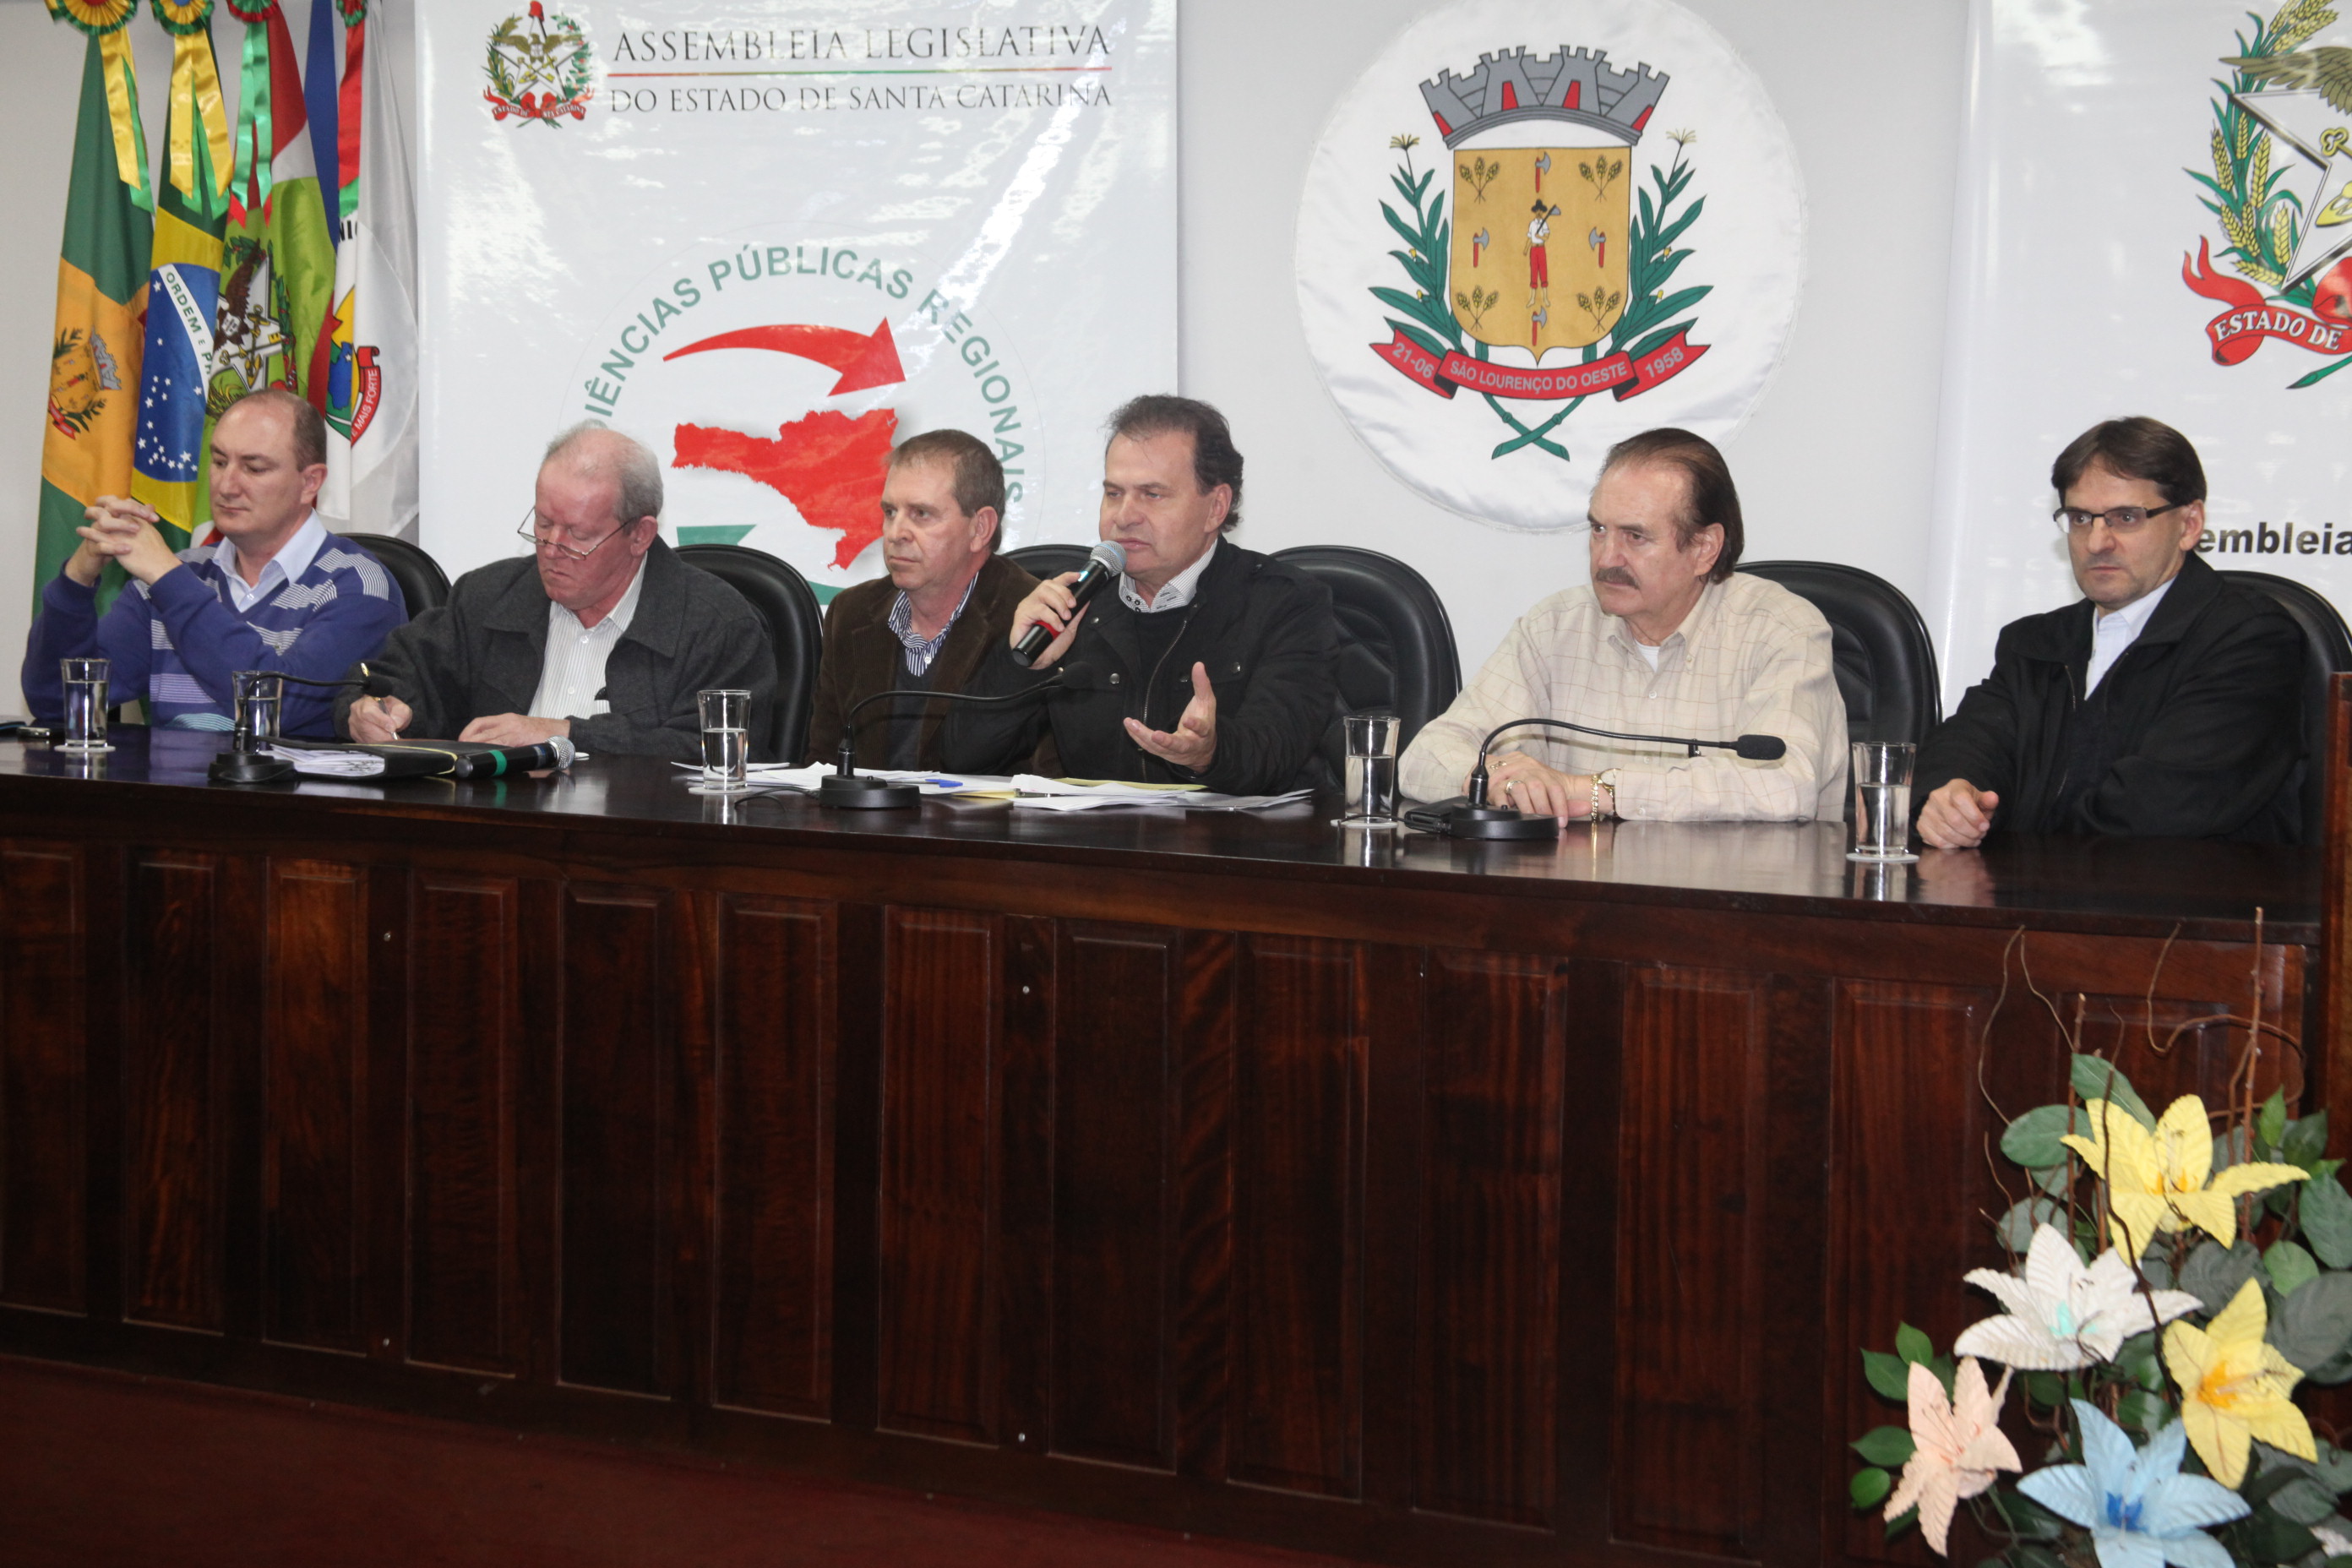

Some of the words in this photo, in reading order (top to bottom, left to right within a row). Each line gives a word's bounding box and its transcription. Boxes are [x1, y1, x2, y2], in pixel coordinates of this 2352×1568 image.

[612, 30, 848, 62] ASSEMBLEIA
[866, 24, 1110, 58] LEGISLATIVA
[610, 88, 656, 112] DO
[670, 87, 787, 112] ESTADO
[799, 86, 838, 111] DE
[849, 85, 946, 110] SANTA
[956, 83, 1113, 108] CATARINA
[166, 271, 203, 334] ORDEM
[2213, 310, 2306, 342] ESTADO
[2307, 324, 2343, 351] DE
[584, 277, 702, 427] IÊNCIAS
[707, 243, 913, 300] PÚBLICAS
[917, 288, 1025, 504] REGIONAIS
[1391, 342, 1435, 379] 21-06
[1450, 360, 1477, 381] SÃO
[1478, 373, 1552, 395] LOURENÇO
[1555, 373, 1578, 391] DO
[1581, 361, 1628, 386] OESTE
[1644, 346, 1685, 378] 1958
[354, 405, 373, 431] MAIS
[365, 369, 378, 405] FORTE
[2197, 521, 2352, 556] embleia
